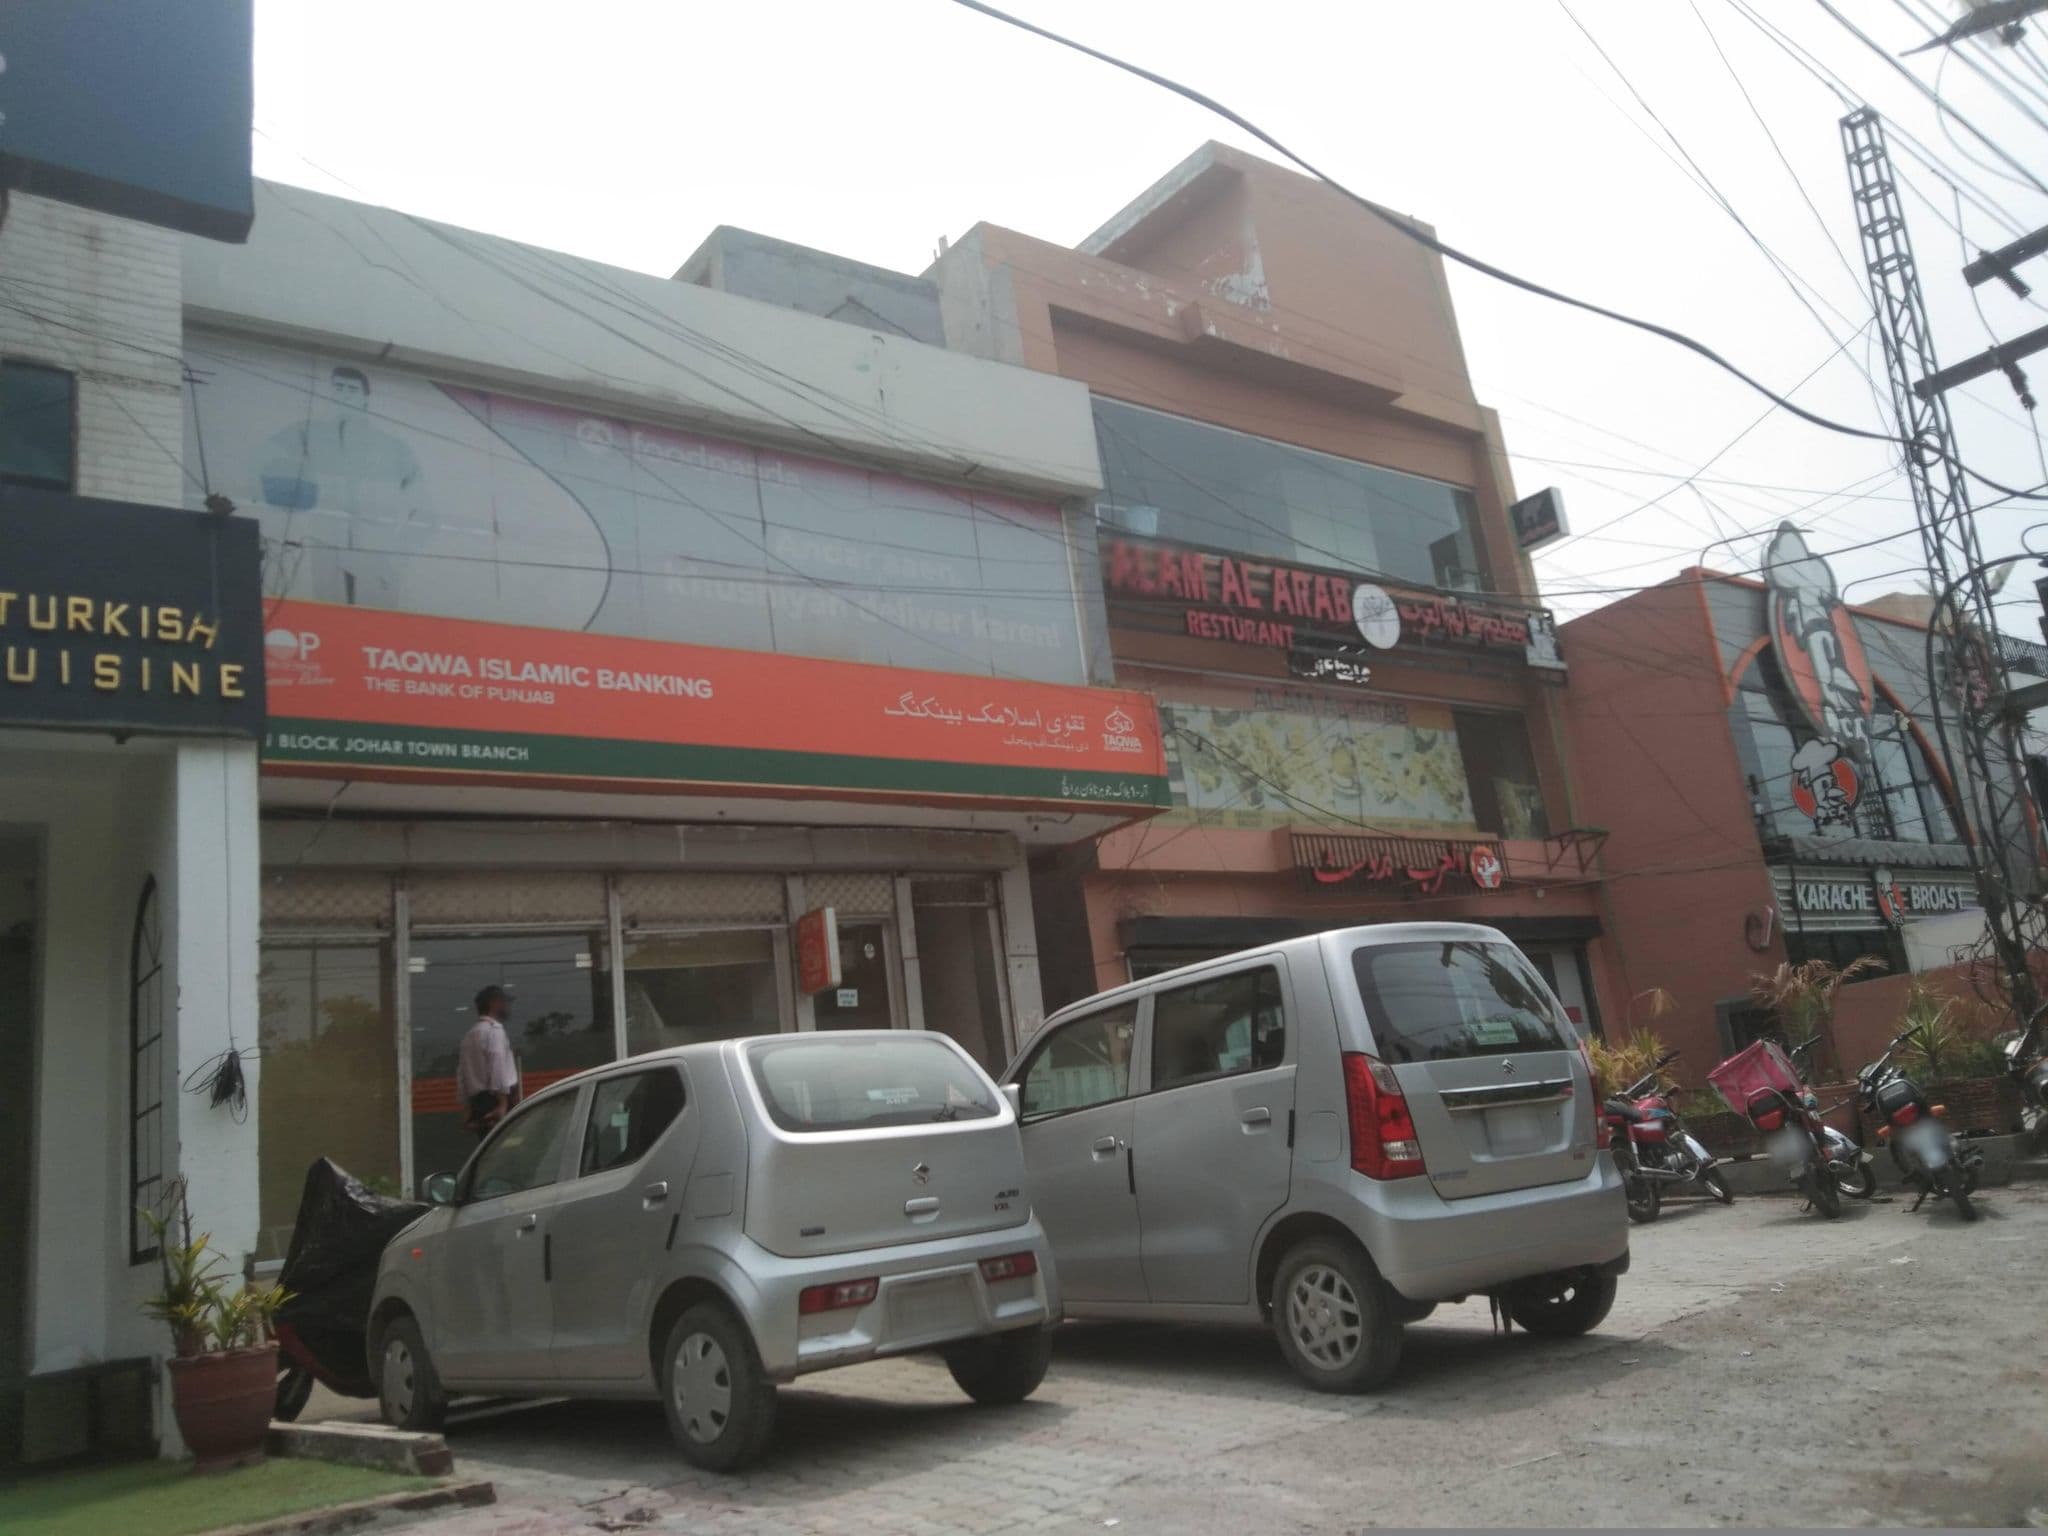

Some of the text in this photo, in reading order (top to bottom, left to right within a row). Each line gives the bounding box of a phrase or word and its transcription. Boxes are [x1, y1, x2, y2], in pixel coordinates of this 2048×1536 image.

[1222, 557, 1261, 609] AL
[1272, 567, 1351, 622] ARAB
[0, 592, 220, 649] TURKISH
[1187, 610, 1295, 649] RESTURANT
[7, 646, 245, 697] UISINE
[362, 645, 713, 699] TAQWA ISLAMIC BANKING
[363, 675, 555, 705] THE BANK OF PUNJAB
[278, 733, 339, 752] BLOCK
[344, 737, 404, 754] JOHAR
[407, 741, 458, 758] TOWN
[461, 744, 529, 761] BRANCH
[1795, 883, 1964, 911] KARACHI BROAST
